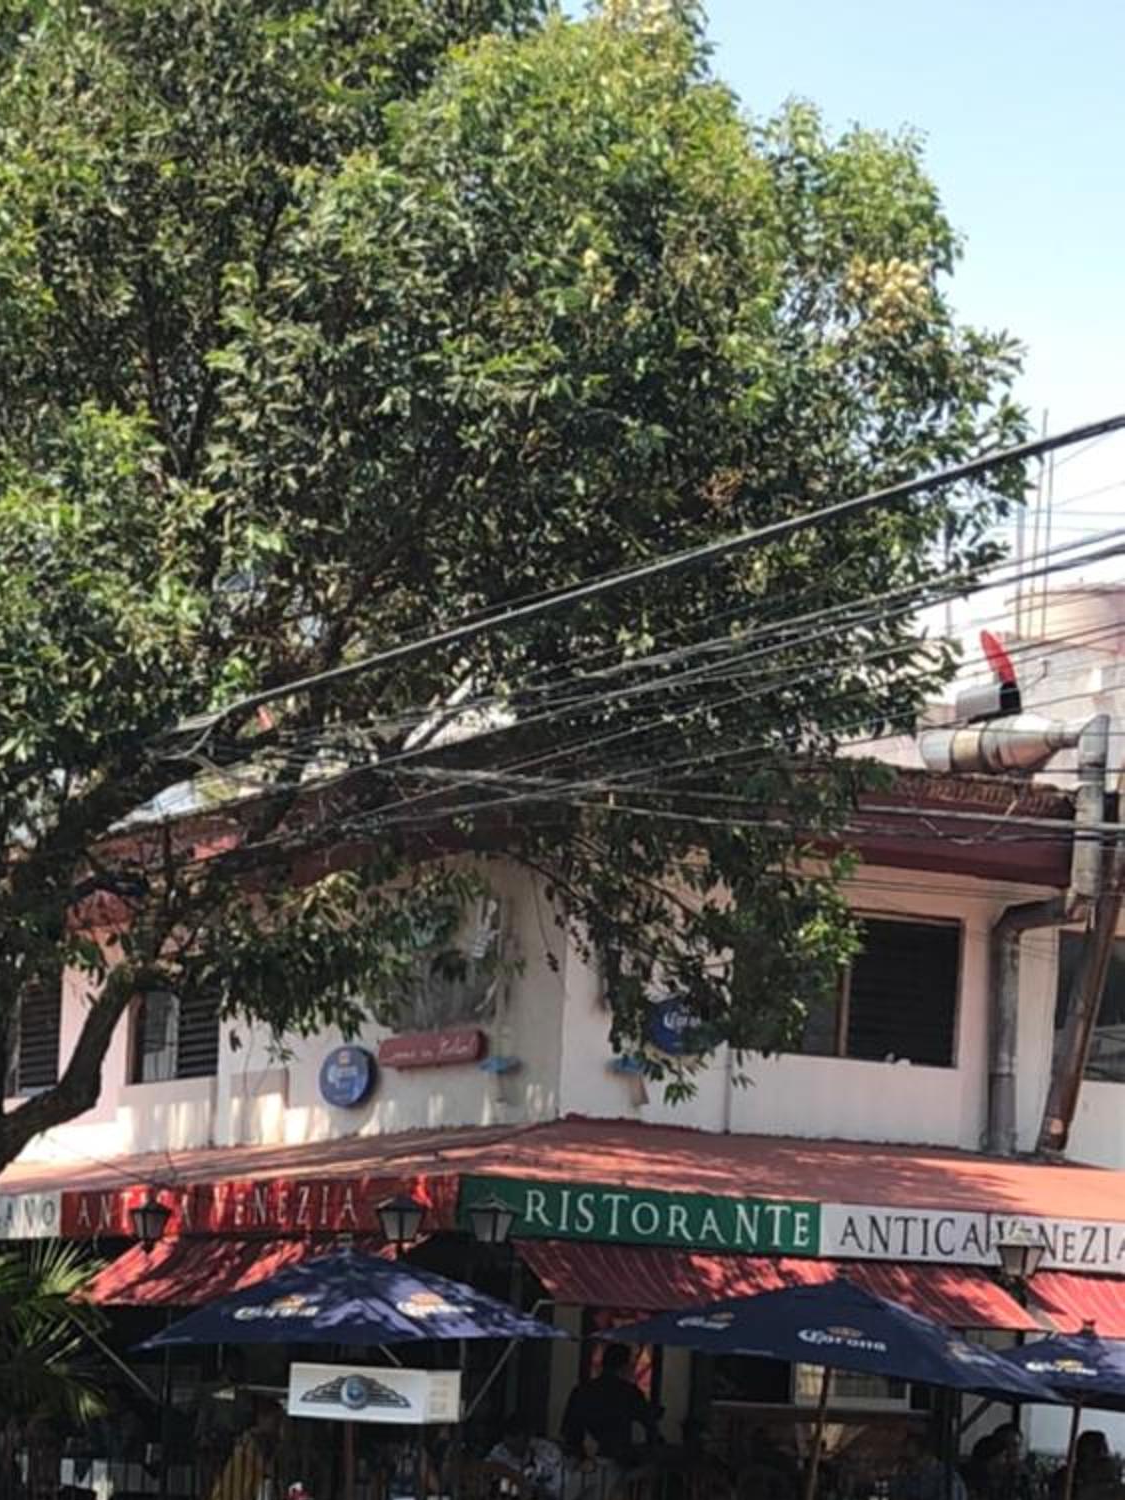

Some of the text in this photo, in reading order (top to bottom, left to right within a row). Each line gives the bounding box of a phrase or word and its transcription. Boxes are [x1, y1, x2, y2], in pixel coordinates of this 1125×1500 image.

[213, 1185, 359, 1229] VENEZIA
[524, 1188, 811, 1248] RISTORANTE
[839, 1213, 987, 1258] ANTICA
[797, 1328, 887, 1352] Corona
